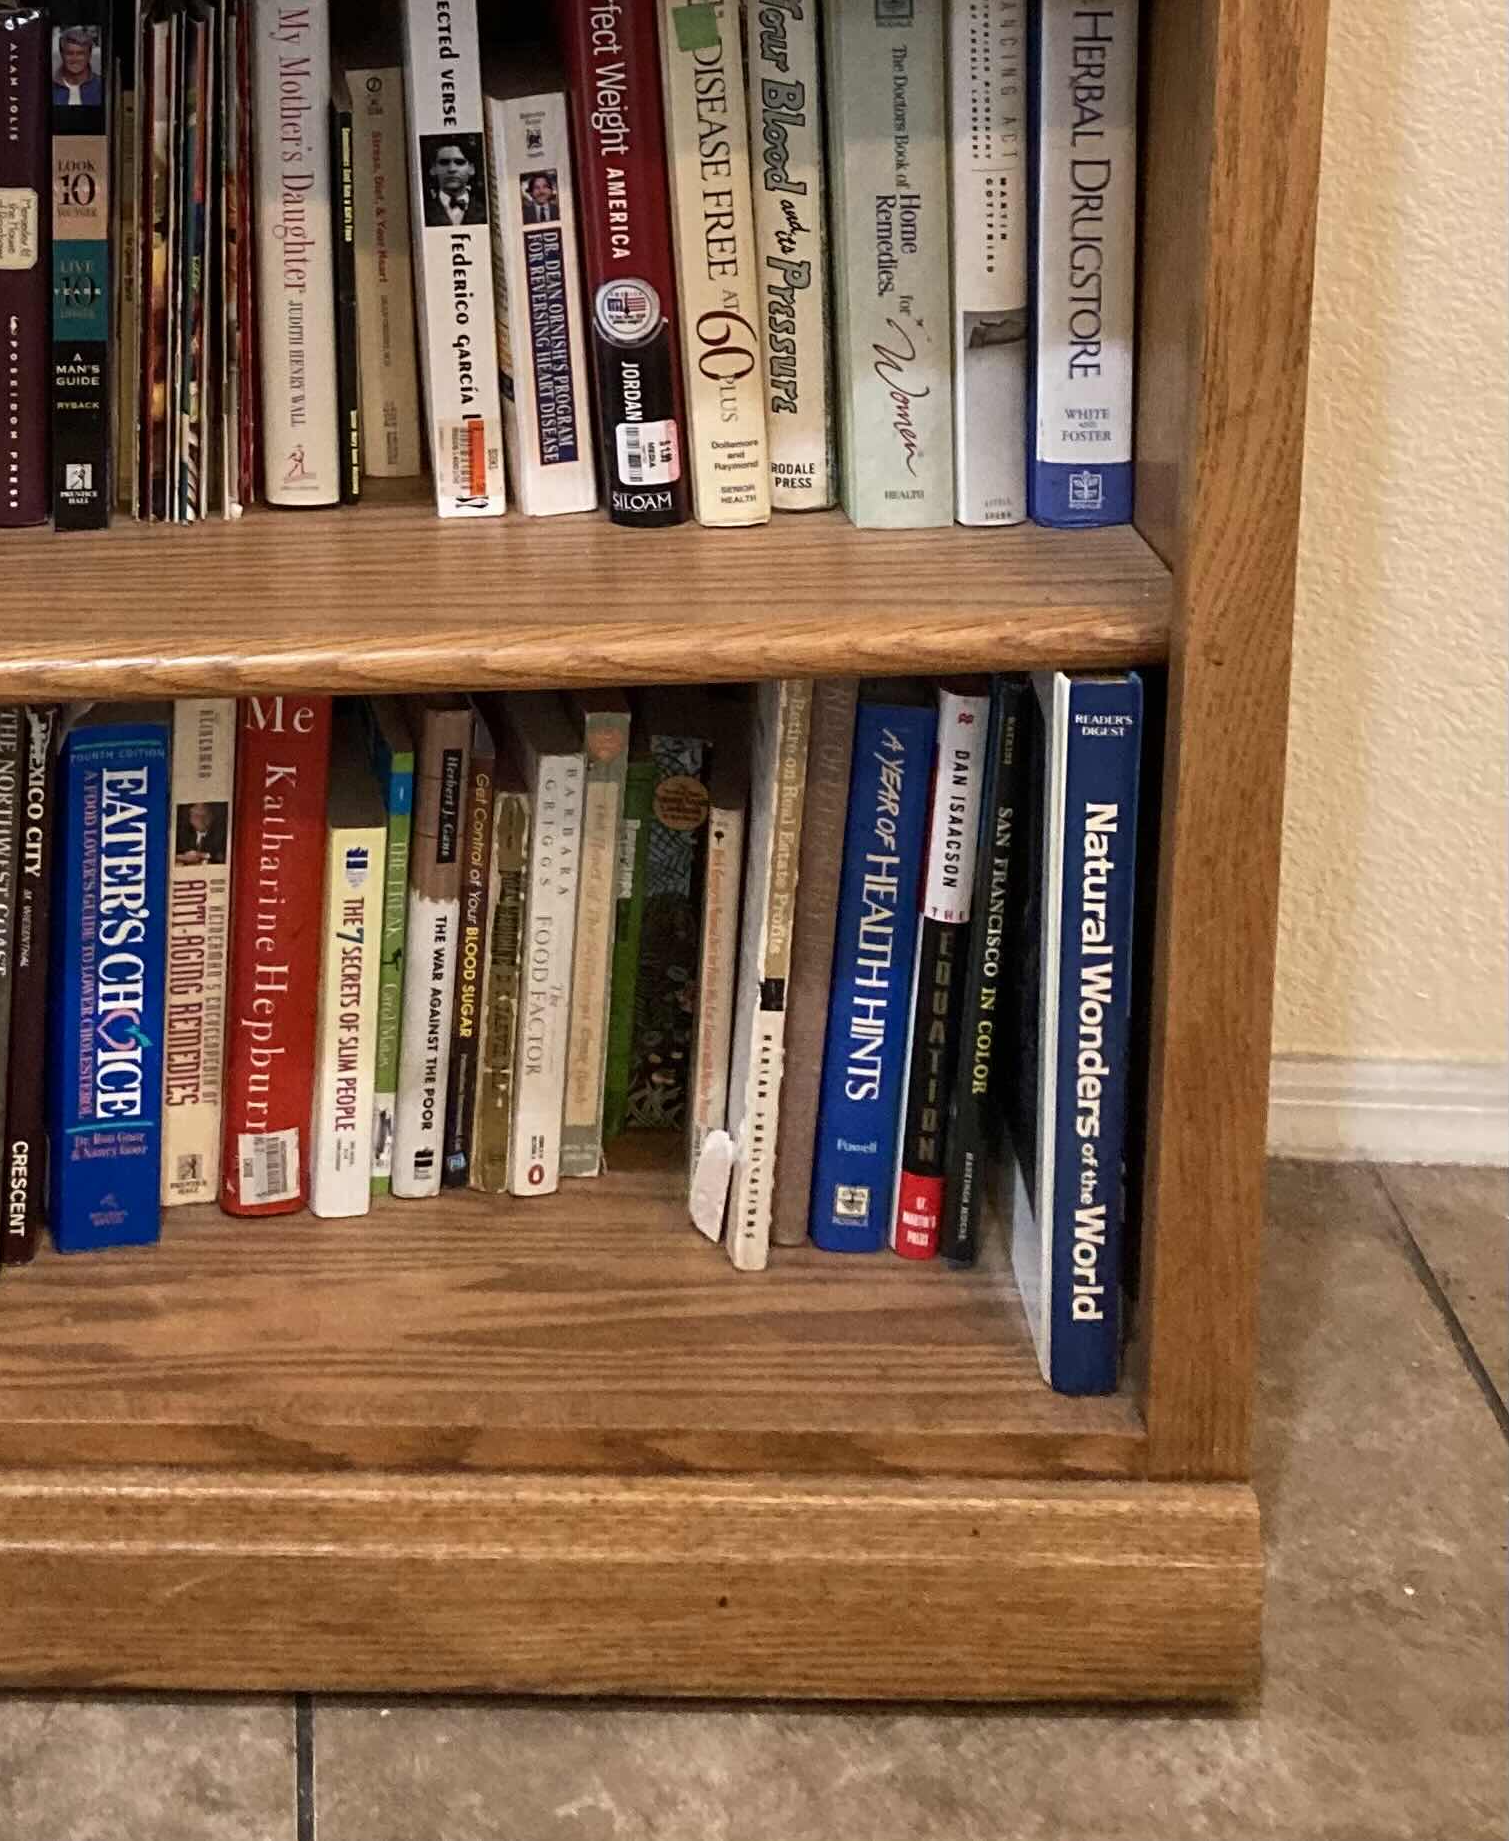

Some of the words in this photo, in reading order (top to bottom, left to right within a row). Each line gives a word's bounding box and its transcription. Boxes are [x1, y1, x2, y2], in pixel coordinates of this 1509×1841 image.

[1070, 7, 1113, 147] HERBAL
[1070, 159, 1112, 379] DRUGSTORE
[622, 361, 642, 421] JORDAN
[1066, 407, 1110, 421] WHITE
[1061, 429, 1112, 443] FOSTER
[771, 461, 816, 477] RODALE
[774, 475, 813, 489] PRESS
[612, 491, 672, 511] SILOAM
[245, 696, 314, 733] Me
[1073, 714, 1134, 726] READER'S
[1081, 726, 1127, 737] DIGEST
[951, 749, 971, 785] DAN
[99, 766, 148, 946] EATER'S
[252, 761, 298, 955] Katharine
[942, 797, 966, 889] ISAACSON
[1081, 803, 1117, 954] Natural
[342, 898, 364, 924] THE
[434, 916, 447, 942] THE
[335, 926, 364, 944] 7
[339, 946, 363, 1009] SECRETS
[431, 949, 445, 983] WAR
[339, 1014, 360, 1034] OF
[427, 989, 443, 1050] AGAINST
[336, 1037, 358, 1073] SLIM
[1078, 961, 1113, 1138] Wonders
[423, 1057, 438, 1083] THE
[332, 1078, 356, 1132] PEOPLE
[419, 1089, 435, 1130] POOR
[1079, 1144, 1097, 1166] of
[8, 1140, 29, 1237] CRESCENT
[1079, 1167, 1095, 1203] the
[1072, 1205, 1107, 1323] World
